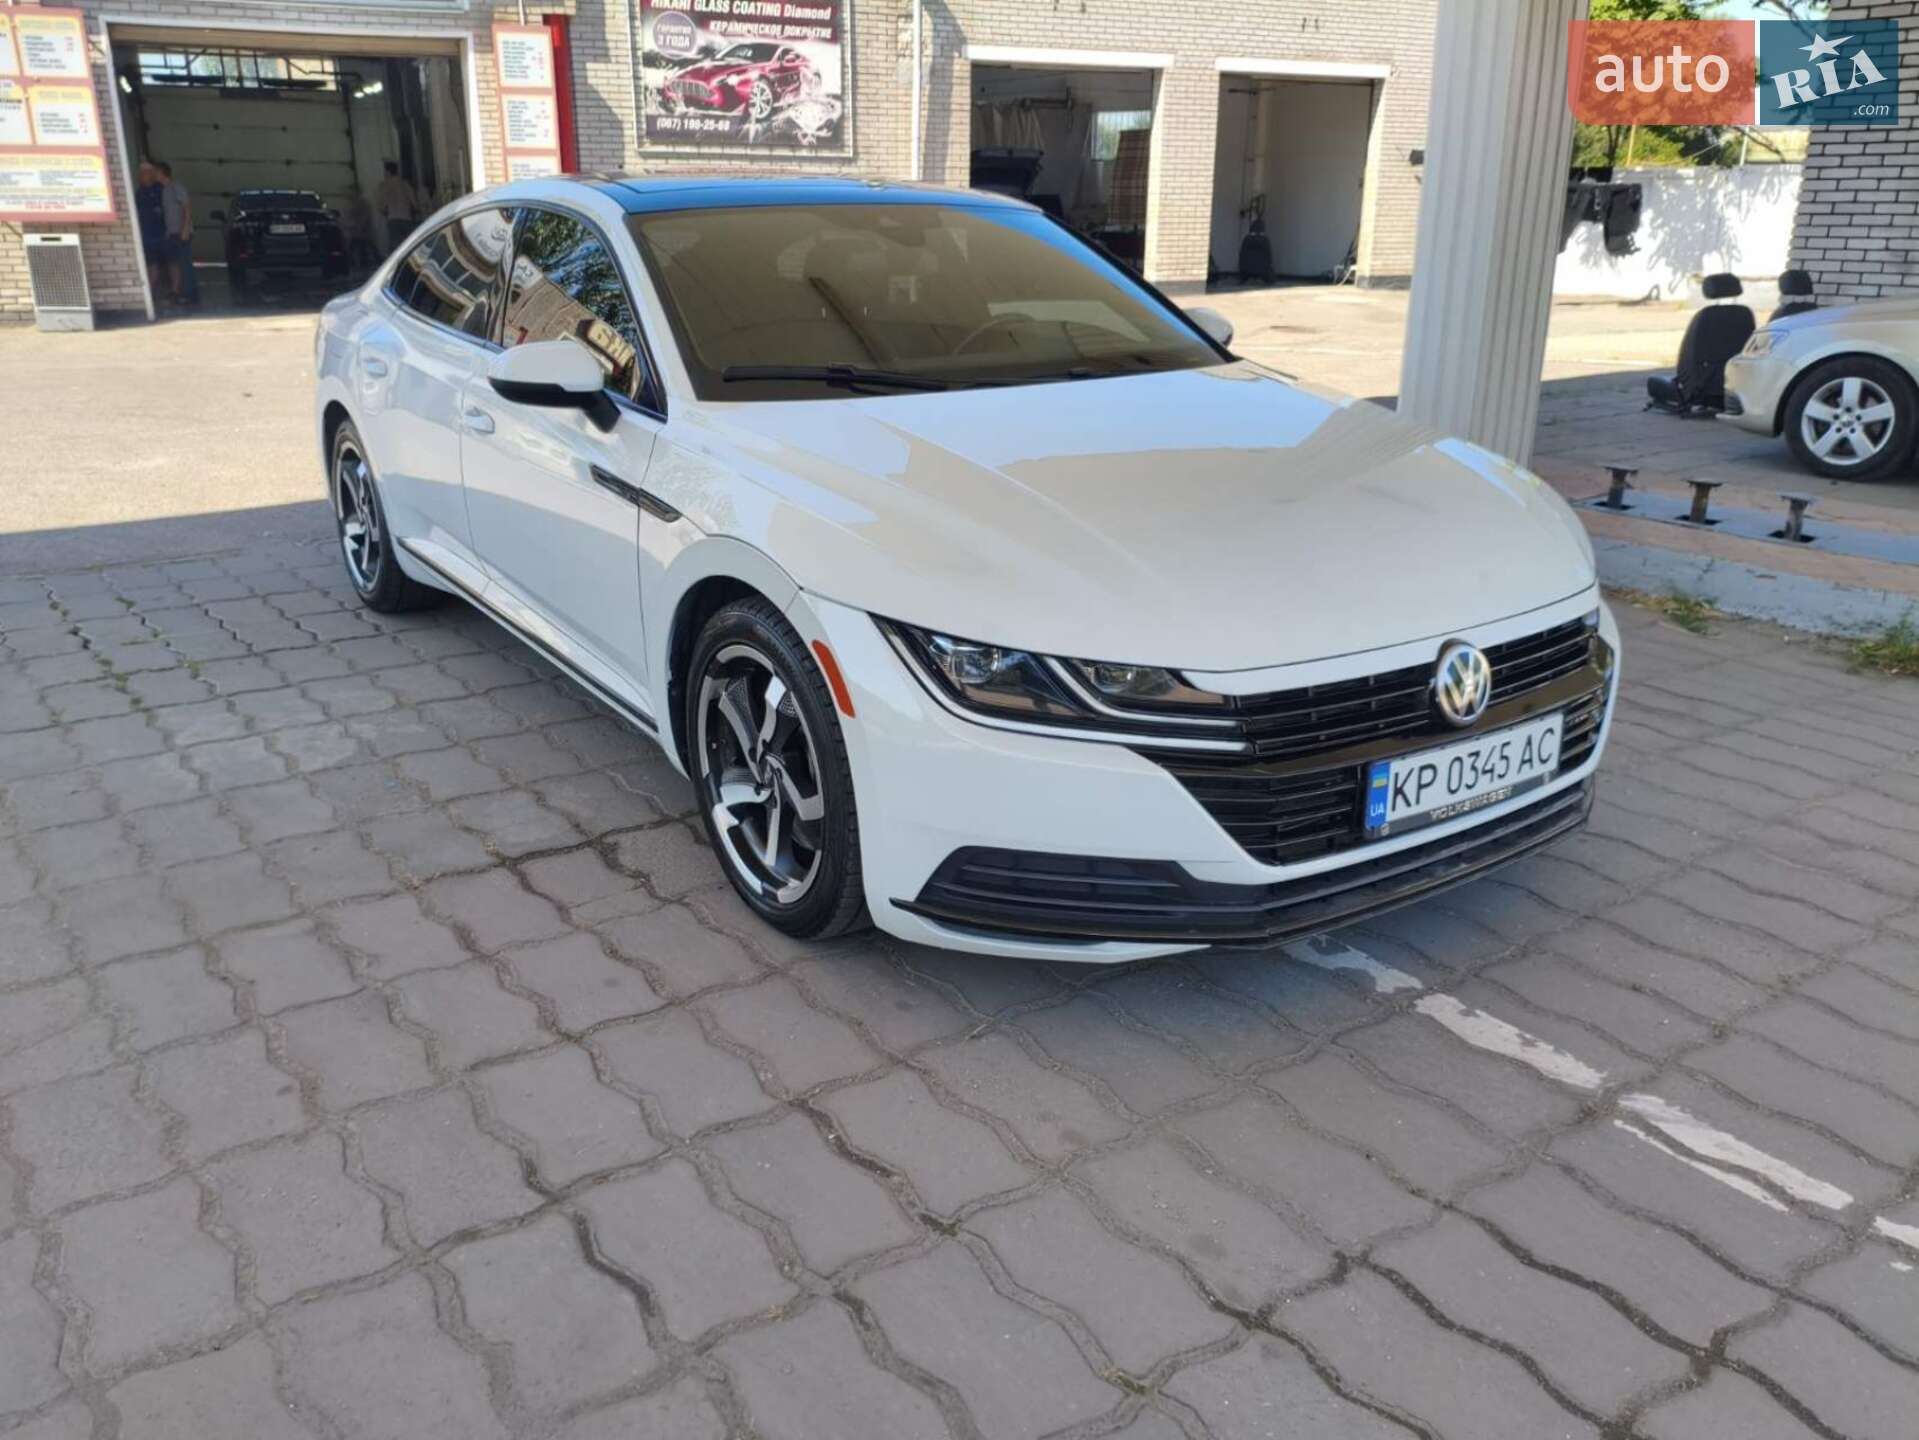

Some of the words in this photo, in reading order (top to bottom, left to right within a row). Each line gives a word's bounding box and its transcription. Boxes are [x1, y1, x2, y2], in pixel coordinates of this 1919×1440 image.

[694, 0, 730, 14] GLASS
[732, 0, 781, 17] COATING
[783, 3, 832, 20] Diamond
[1391, 762, 1438, 812] KP
[1446, 741, 1511, 795] 0345
[1517, 727, 1555, 774] AC
[1369, 801, 1385, 817] UA
